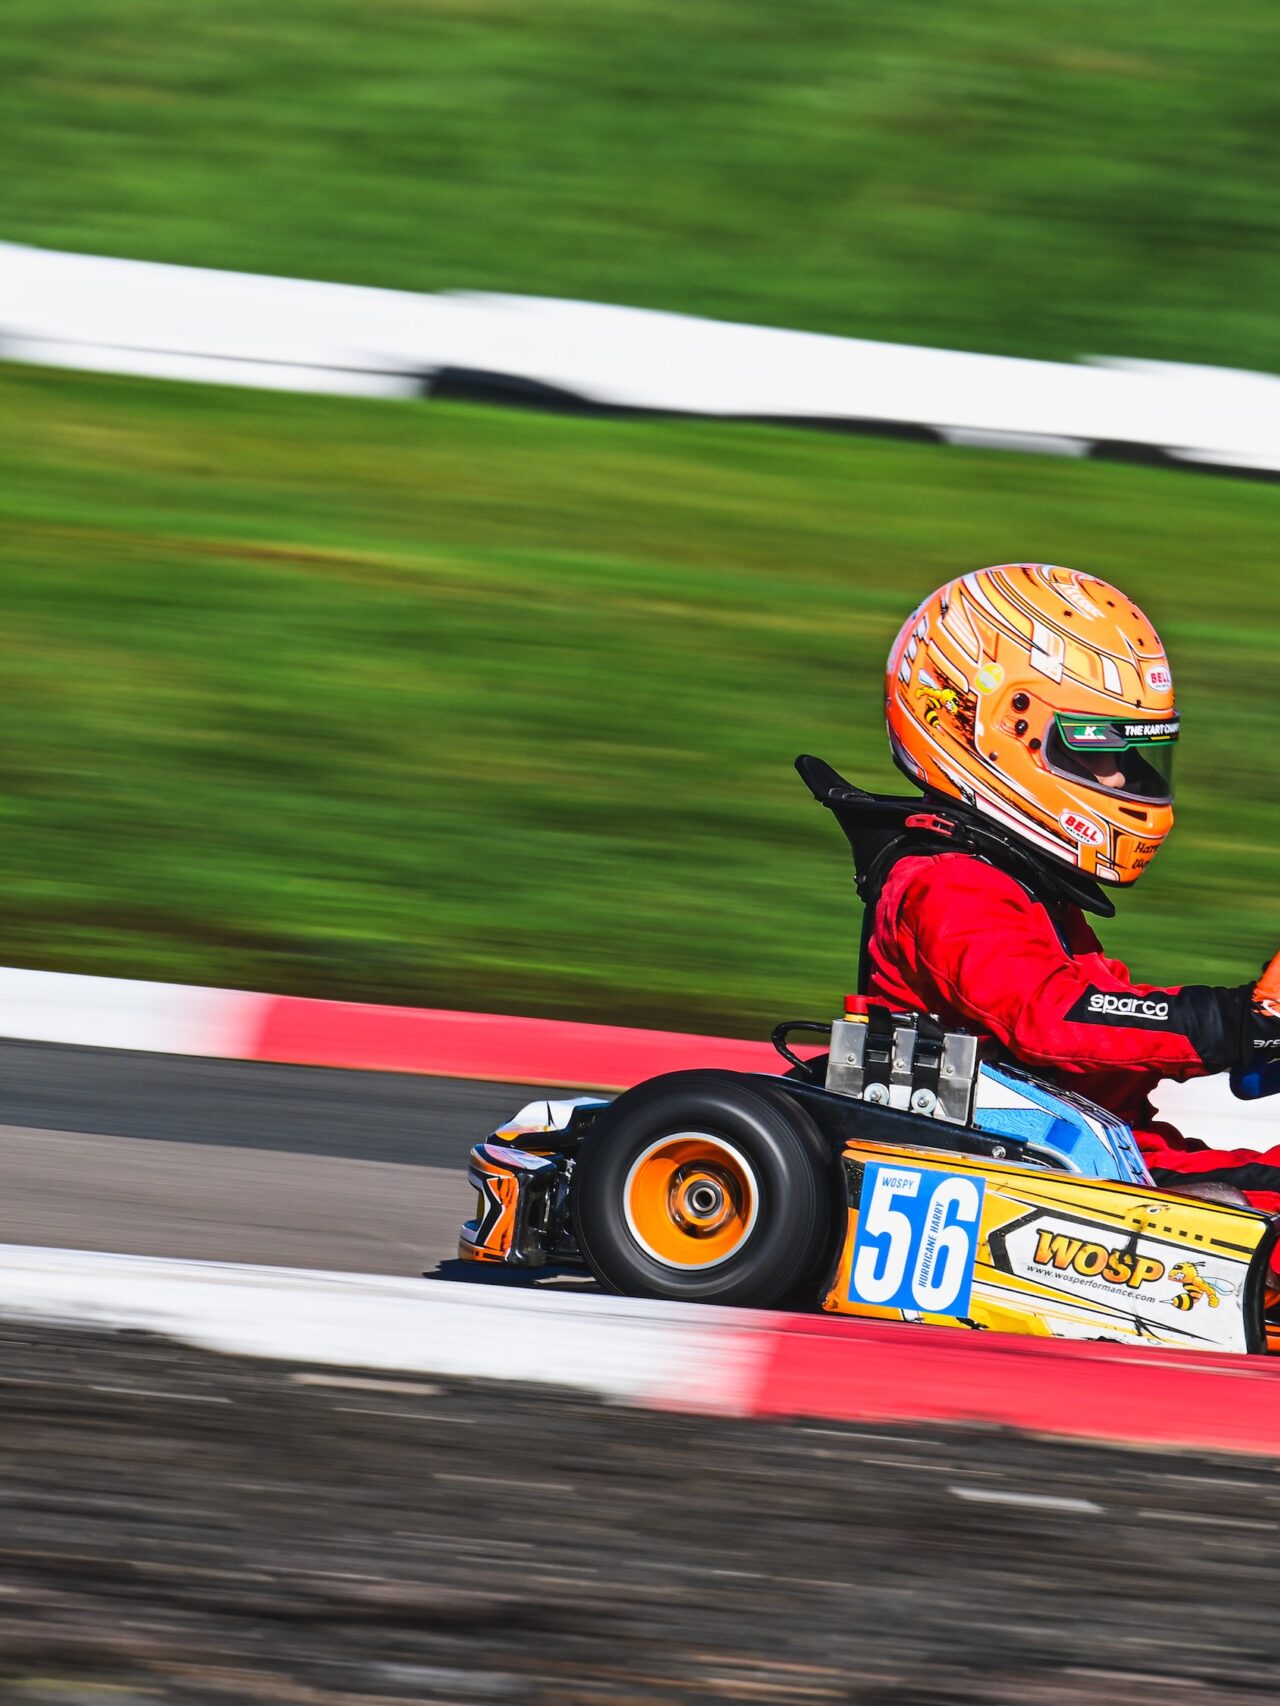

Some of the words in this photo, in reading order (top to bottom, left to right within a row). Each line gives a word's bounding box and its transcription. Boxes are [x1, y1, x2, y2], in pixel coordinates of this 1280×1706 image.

[1124, 725, 1143, 736] THE
[1144, 724, 1163, 736] KART
[1065, 815, 1097, 841] BELL
[1090, 993, 1168, 1018] sparco
[882, 1176, 914, 1190] WOSPY
[854, 1167, 979, 1311] 56
[918, 1236, 937, 1288] HURRICANE
[930, 1201, 944, 1233] HARRY
[1033, 1228, 1165, 1289] WOSP
[1027, 1265, 1156, 1303] www.wosperformance.com
